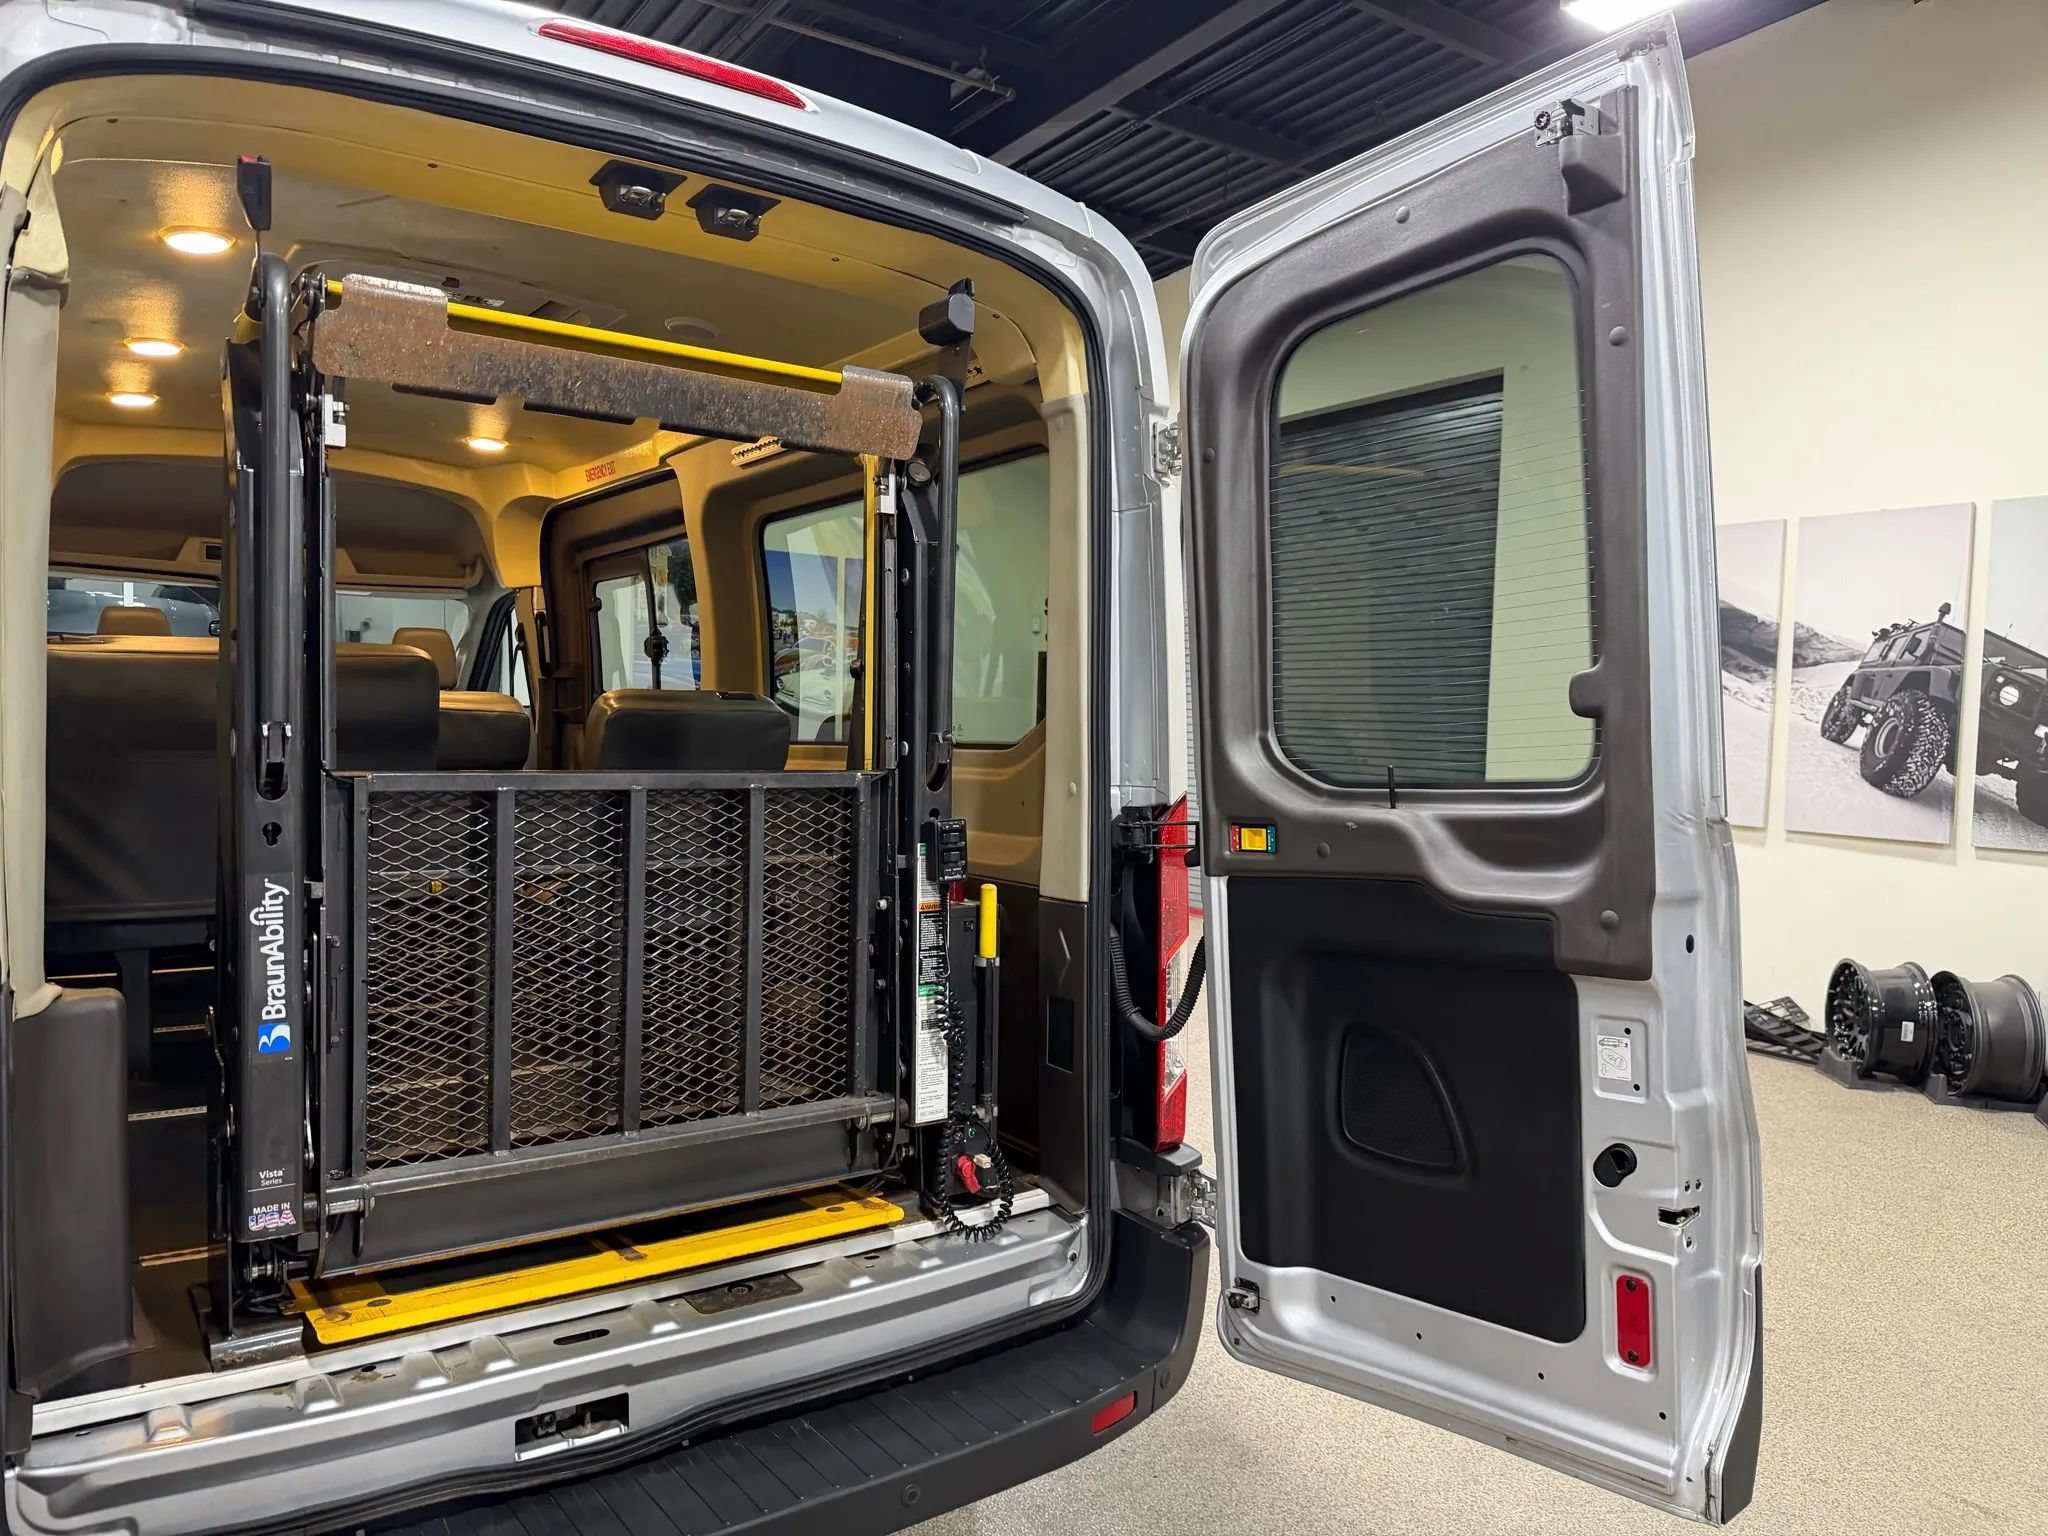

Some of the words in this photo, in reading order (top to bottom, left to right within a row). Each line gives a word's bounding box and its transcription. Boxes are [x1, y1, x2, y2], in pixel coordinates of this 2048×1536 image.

[585, 464, 607, 482] EMERGENCY
[250, 880, 290, 1020] BraunAbility
[259, 1169, 283, 1179] Vista
[261, 1178, 282, 1187] Series
[253, 1204, 279, 1215] MADE
[281, 1202, 290, 1210] IN
[249, 1210, 296, 1232] USA
